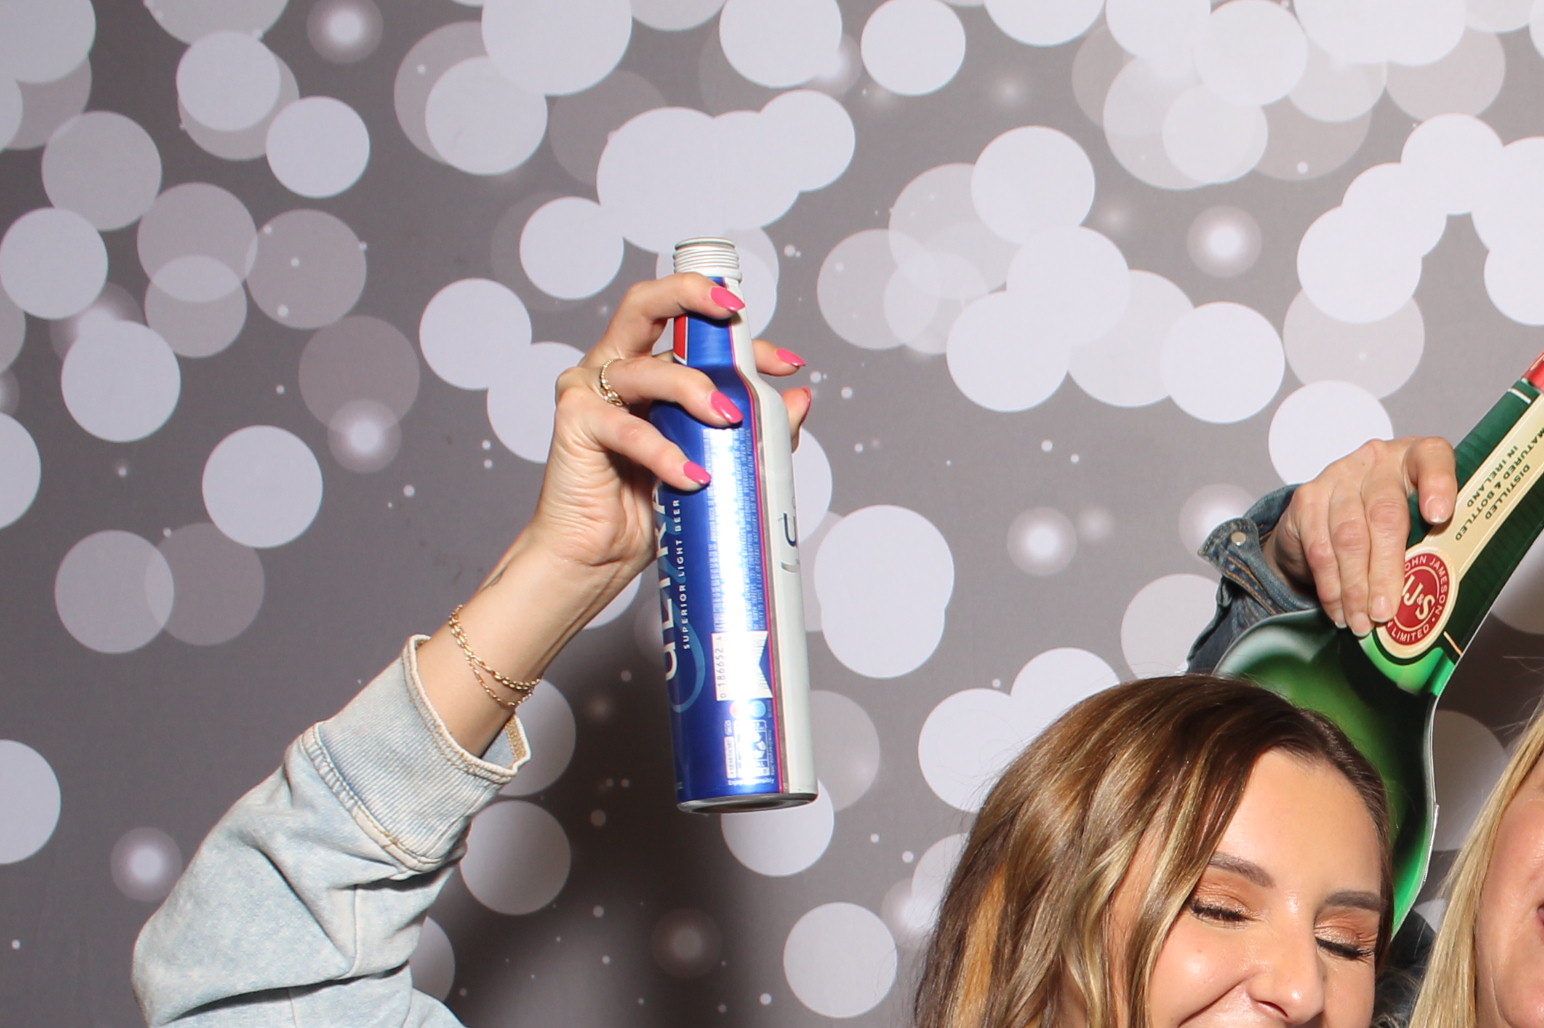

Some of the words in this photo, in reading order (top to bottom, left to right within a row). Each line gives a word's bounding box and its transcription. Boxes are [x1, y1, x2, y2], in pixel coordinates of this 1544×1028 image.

[1506, 445, 1519, 458] IN
[1466, 459, 1508, 507] IRELAND
[1484, 463, 1531, 520] DISTILLED
[1494, 481, 1503, 490] &
[672, 500, 682, 532] BEER
[1455, 491, 1496, 541] BOTTLED
[675, 539, 686, 577] LIGHT
[1404, 555, 1428, 572] OHN
[1429, 558, 1448, 615] JAMESON
[679, 584, 691, 650] SUPERIOR
[1391, 623, 1431, 643] LIMITED
